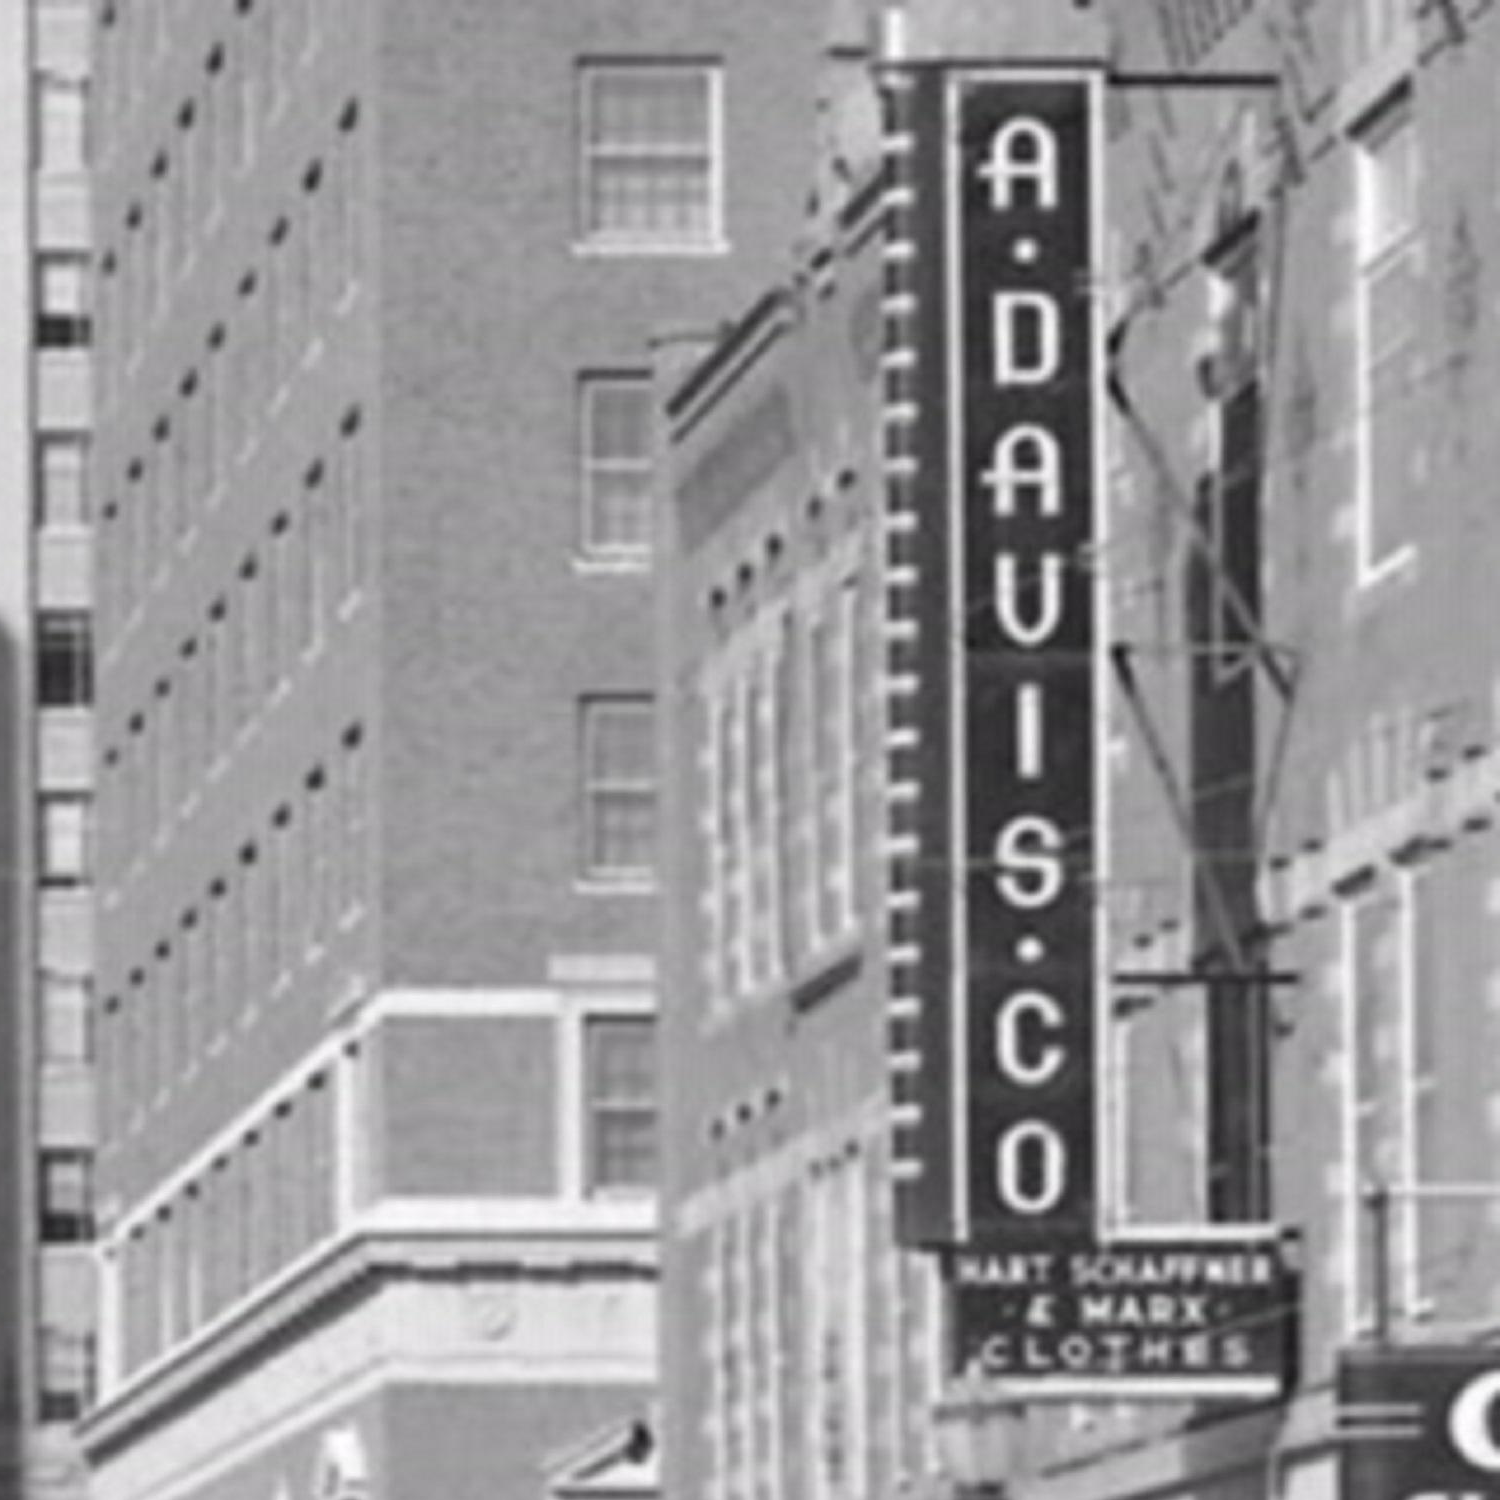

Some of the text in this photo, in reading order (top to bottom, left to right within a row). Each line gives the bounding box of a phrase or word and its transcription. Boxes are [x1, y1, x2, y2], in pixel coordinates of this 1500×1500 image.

[955, 1252, 1271, 1287] HART SCHAFFNER
[1080, 1294, 1208, 1327] MARX
[981, 1334, 1251, 1374] CLOTHES
